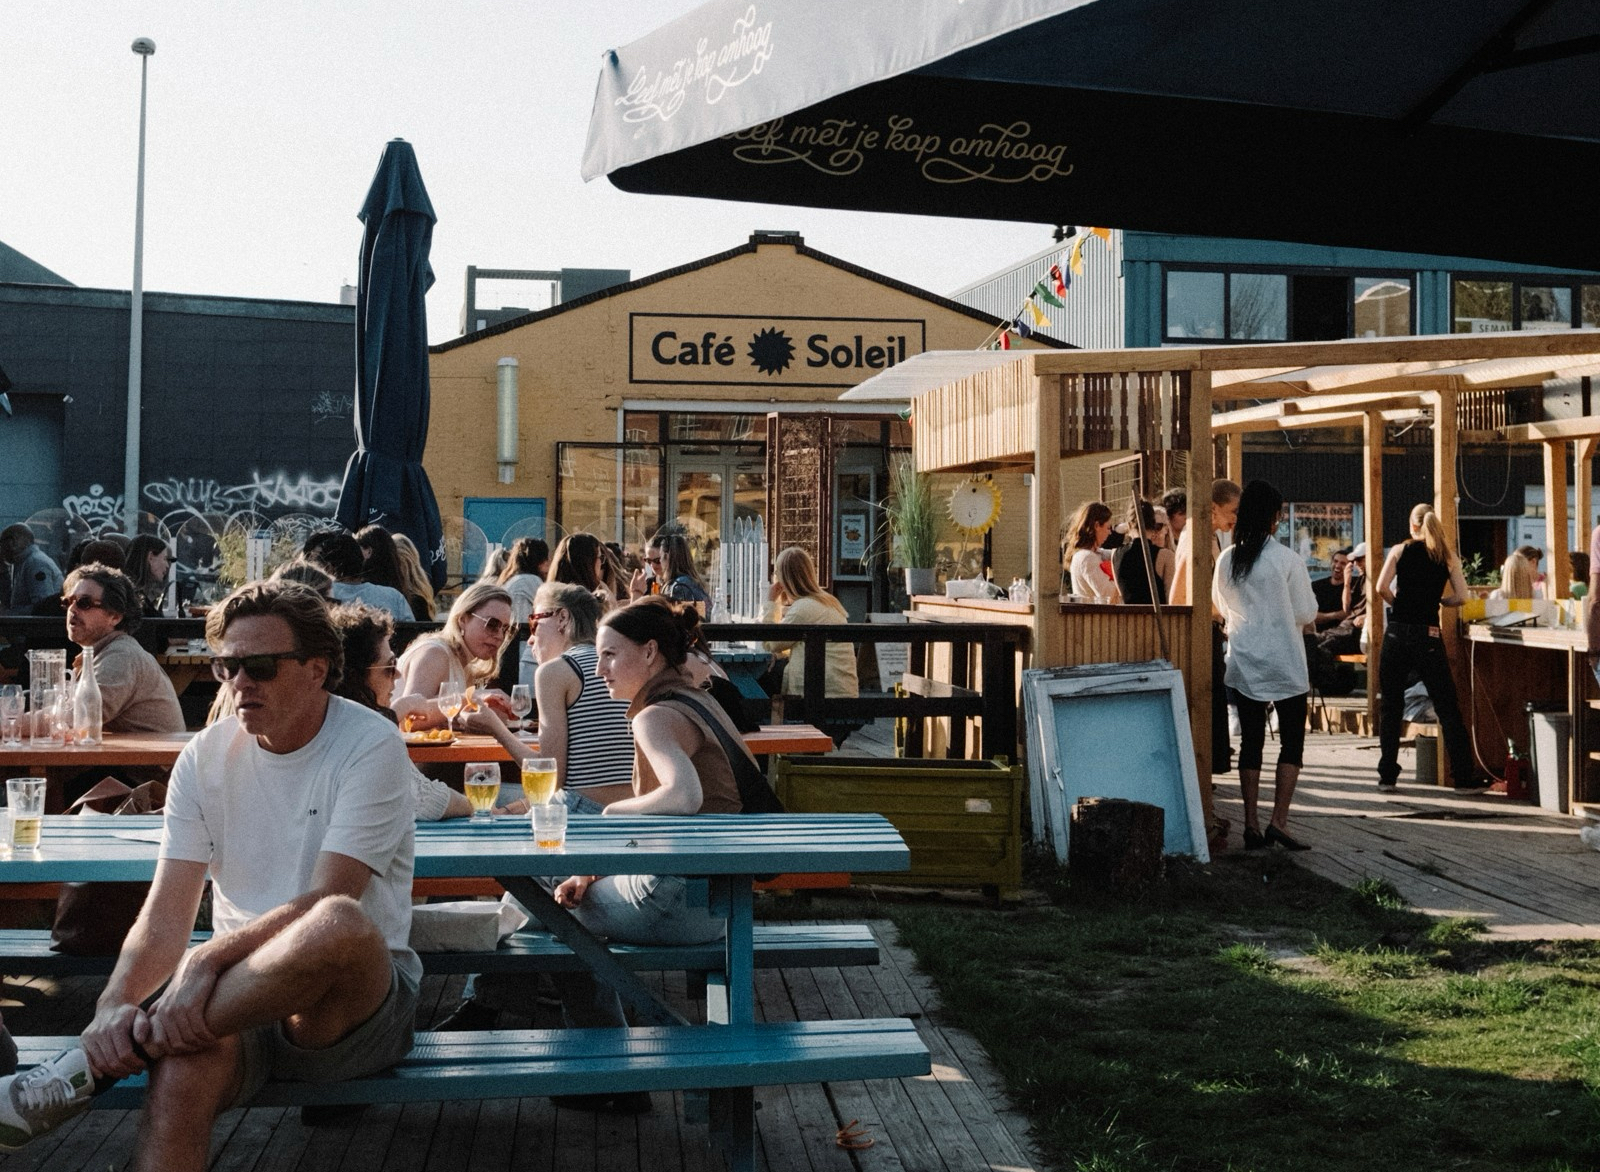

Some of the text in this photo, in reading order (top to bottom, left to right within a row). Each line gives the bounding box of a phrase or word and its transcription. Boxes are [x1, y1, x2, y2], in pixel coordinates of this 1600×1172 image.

[694, 37, 716, 86] kop
[711, 4, 773, 90] omhoog
[789, 119, 857, 147] met
[884, 115, 941, 163] kop
[946, 121, 1074, 182] omhoog
[651, 330, 906, 369] Café Soleil
